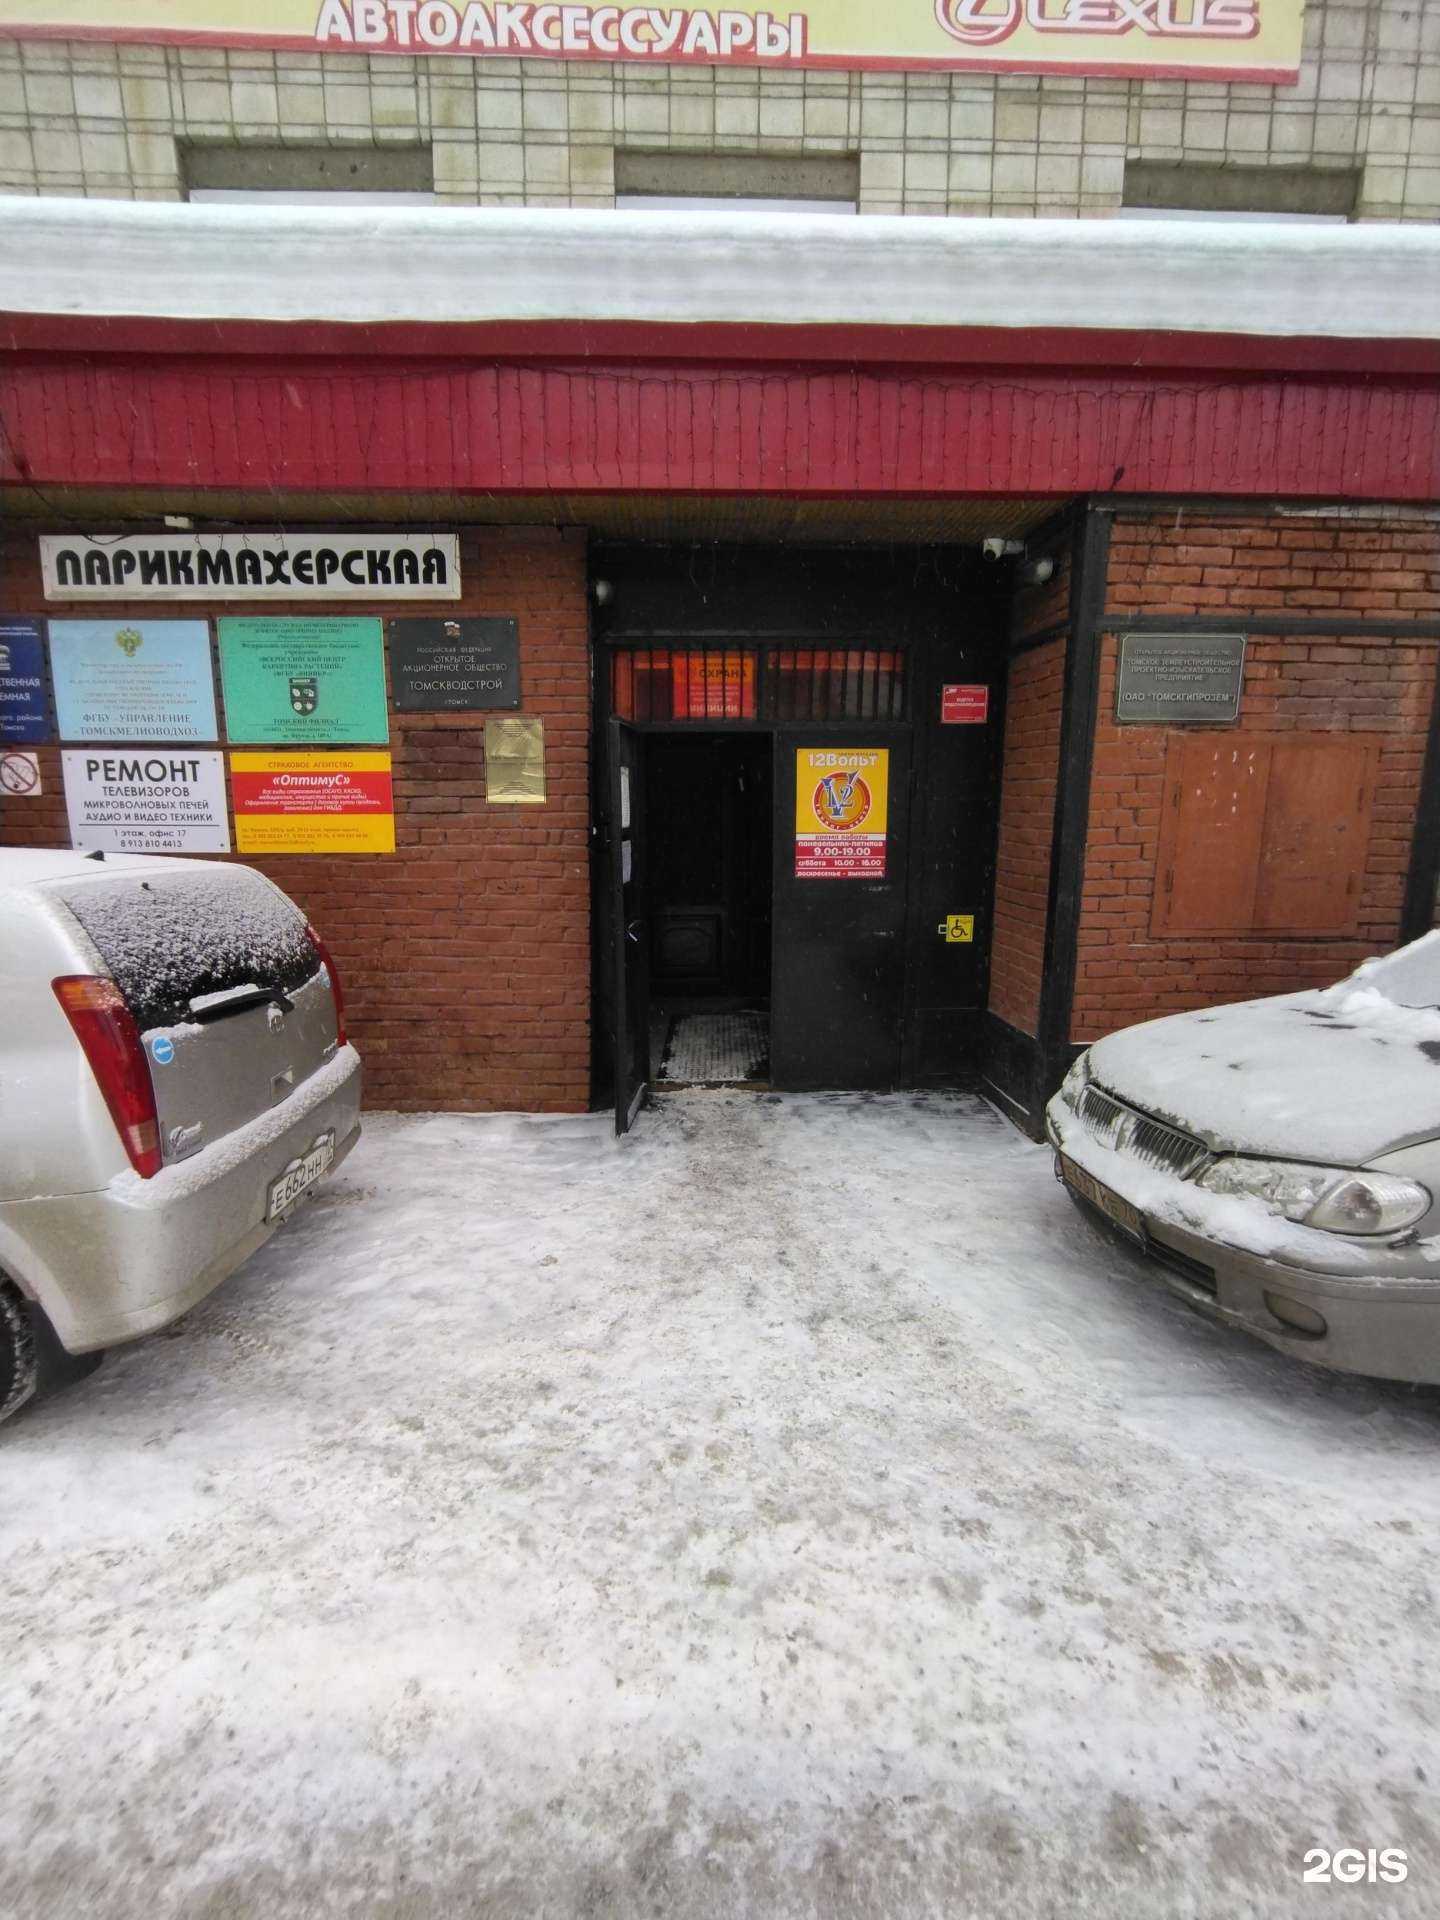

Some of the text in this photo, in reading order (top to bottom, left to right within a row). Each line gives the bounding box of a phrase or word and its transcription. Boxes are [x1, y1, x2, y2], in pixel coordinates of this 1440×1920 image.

[1026, 0, 1259, 38] LEXUS
[315, 0, 807, 57] АВТОАКСЕССУАРЫ
[56, 549, 448, 585] ПАРИКМАХЕРСКАЯ
[433, 655, 476, 663] ОТКРЫТОЕ
[402, 663, 507, 672] АКЦИОНЕРНОЕ ОБЩЕСТВО
[410, 679, 503, 691] ТОМСКВОДСТРОЙ
[808, 752, 878, 767] 12Вольт
[86, 759, 200, 782] РЕМОНТ
[272, 774, 351, 787] «ОптимуС»
[102, 786, 190, 797] ТЕЛЕВИЗОРОВ
[84, 799, 209, 809] МИКРОВОЛНОВЫХ ПЕЧЕЙ
[86, 813, 212, 822] АУДИО И ВИДЕО ТЕХНИКИ
[149, 830, 175, 839] офис
[177, 829, 187, 837] 17
[162, 840, 183, 848] 4413
